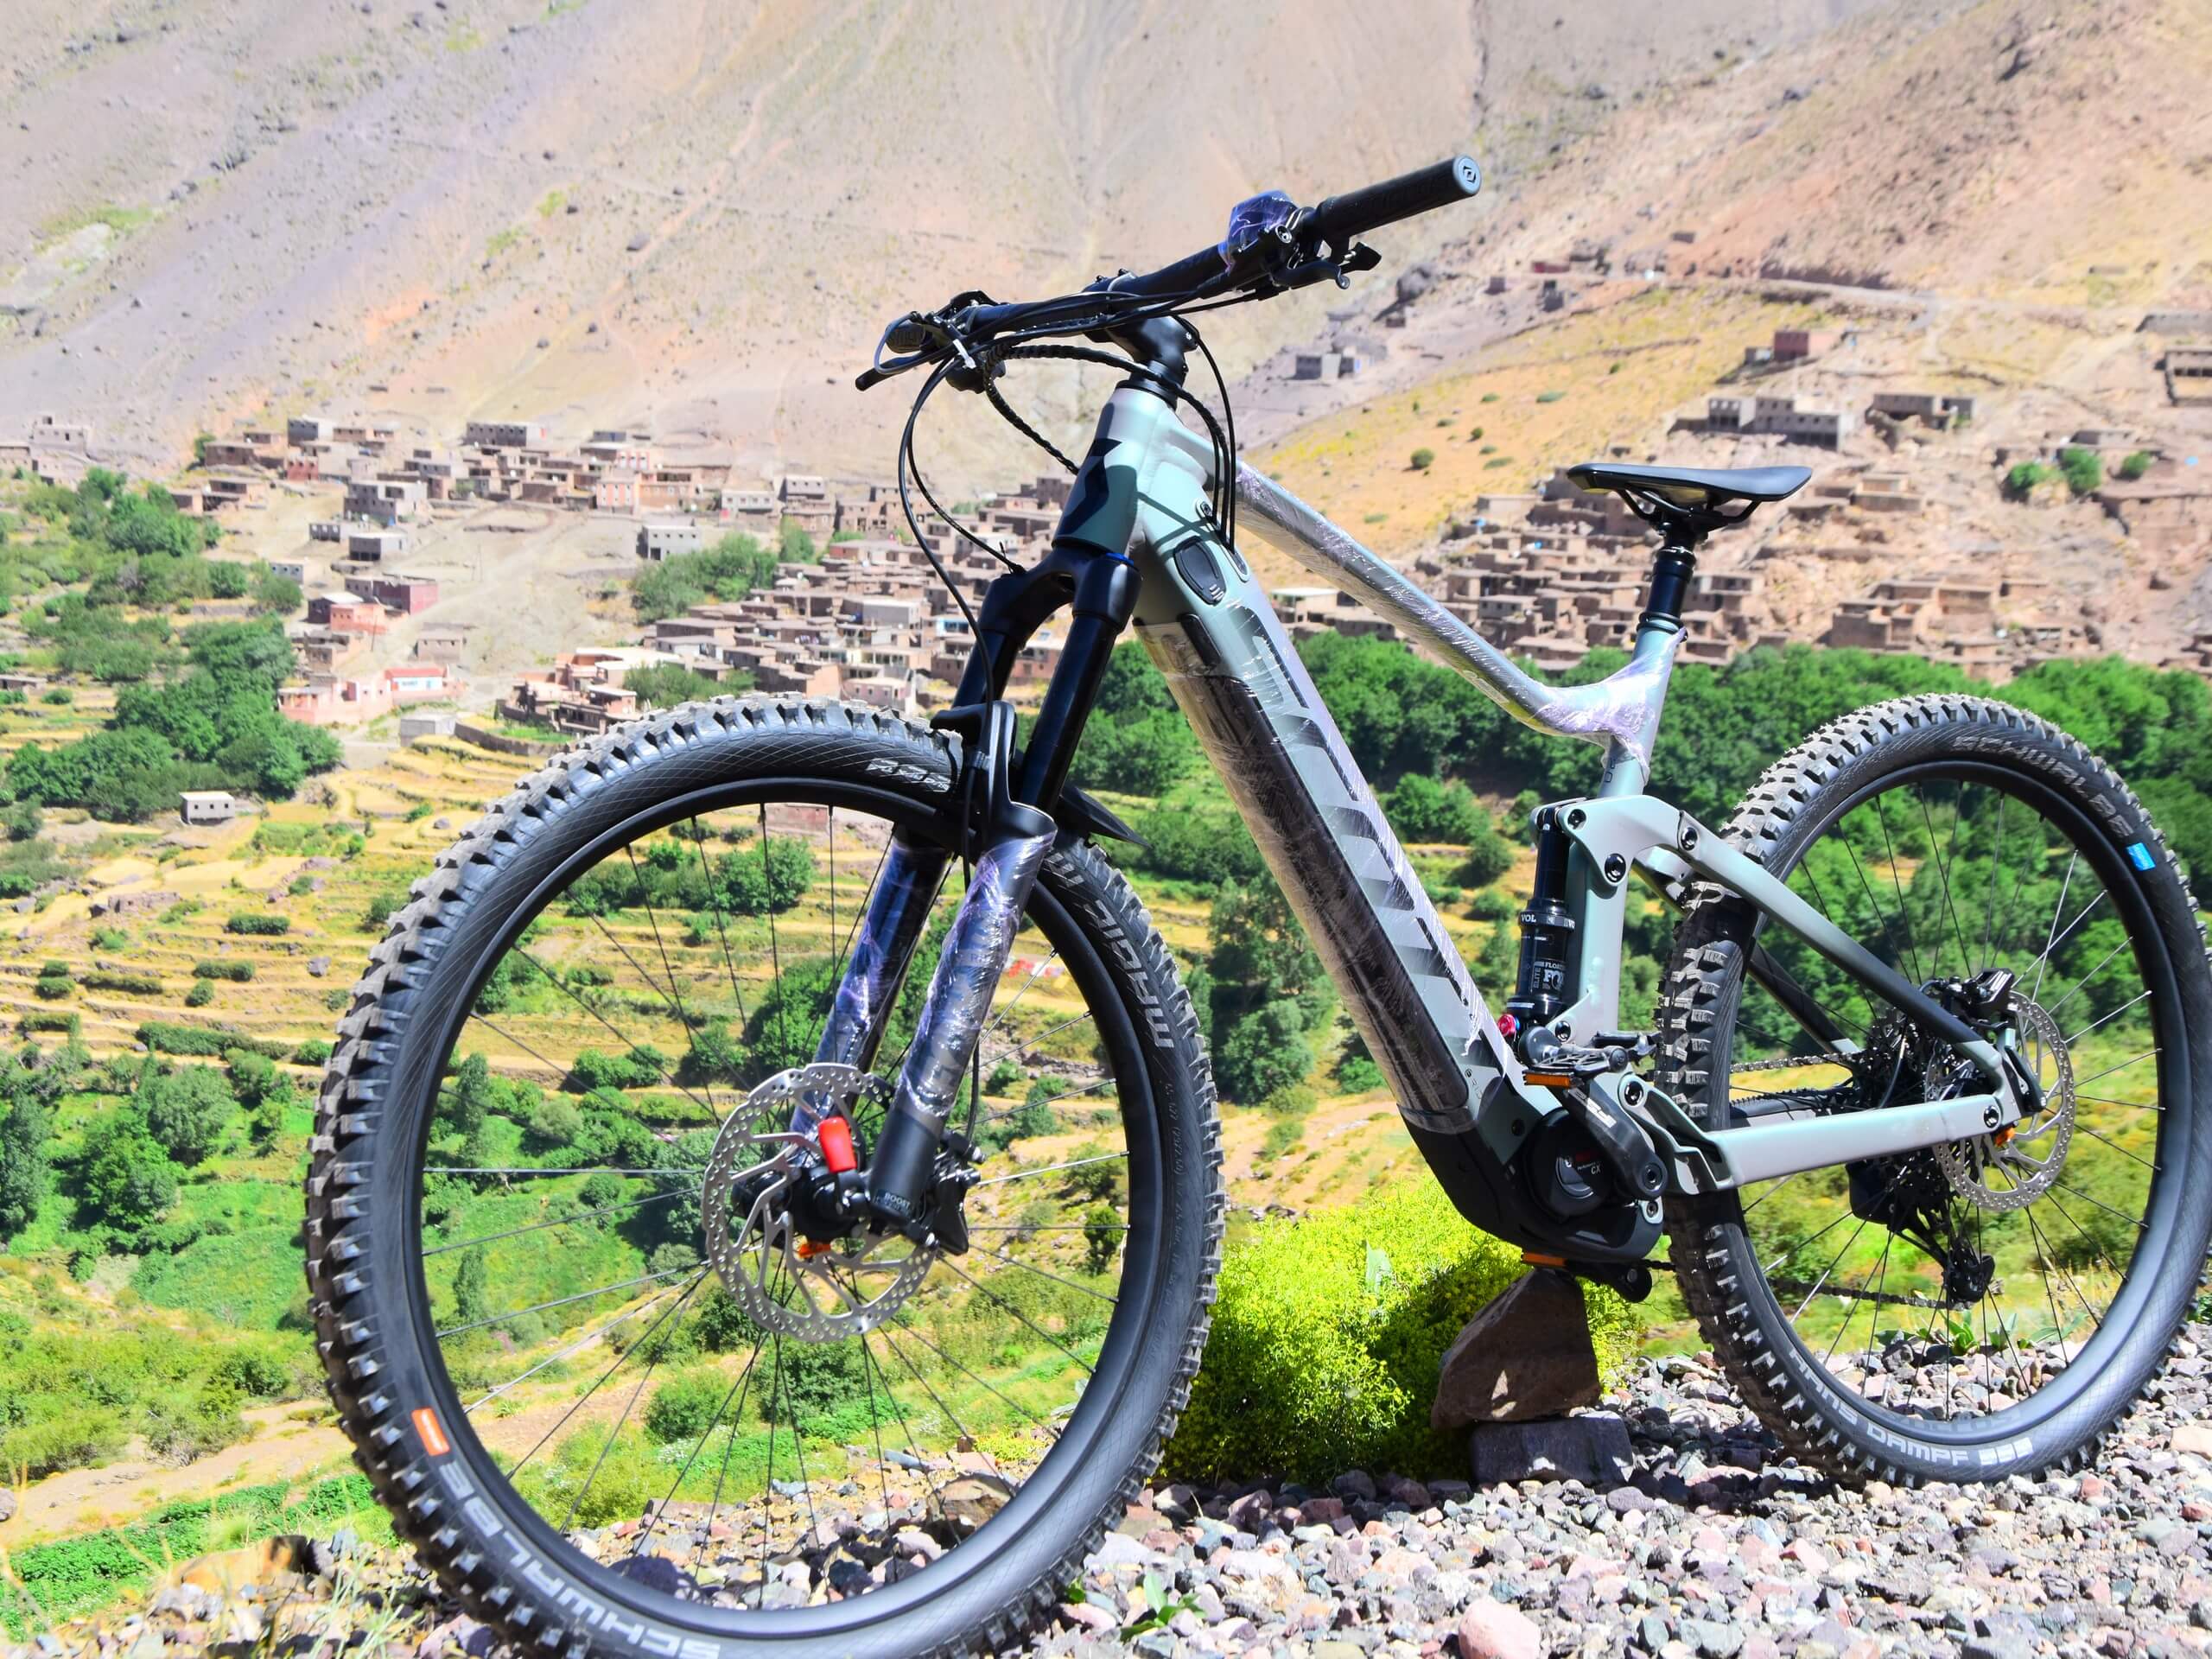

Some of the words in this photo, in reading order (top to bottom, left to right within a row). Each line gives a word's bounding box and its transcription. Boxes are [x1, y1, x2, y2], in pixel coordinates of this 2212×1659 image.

[1952, 735, 2135, 838] SCHWALBE
[1521, 914, 1537, 923] VOL
[1083, 899, 1175, 1048] MAGIC
[884, 1192, 912, 1208] BOOST
[1591, 1165, 1601, 1175] CX
[1789, 1349, 1859, 1426] HANS
[1866, 1421, 1969, 1466] DAMPF
[438, 1459, 722, 1659] SCHWALBE
